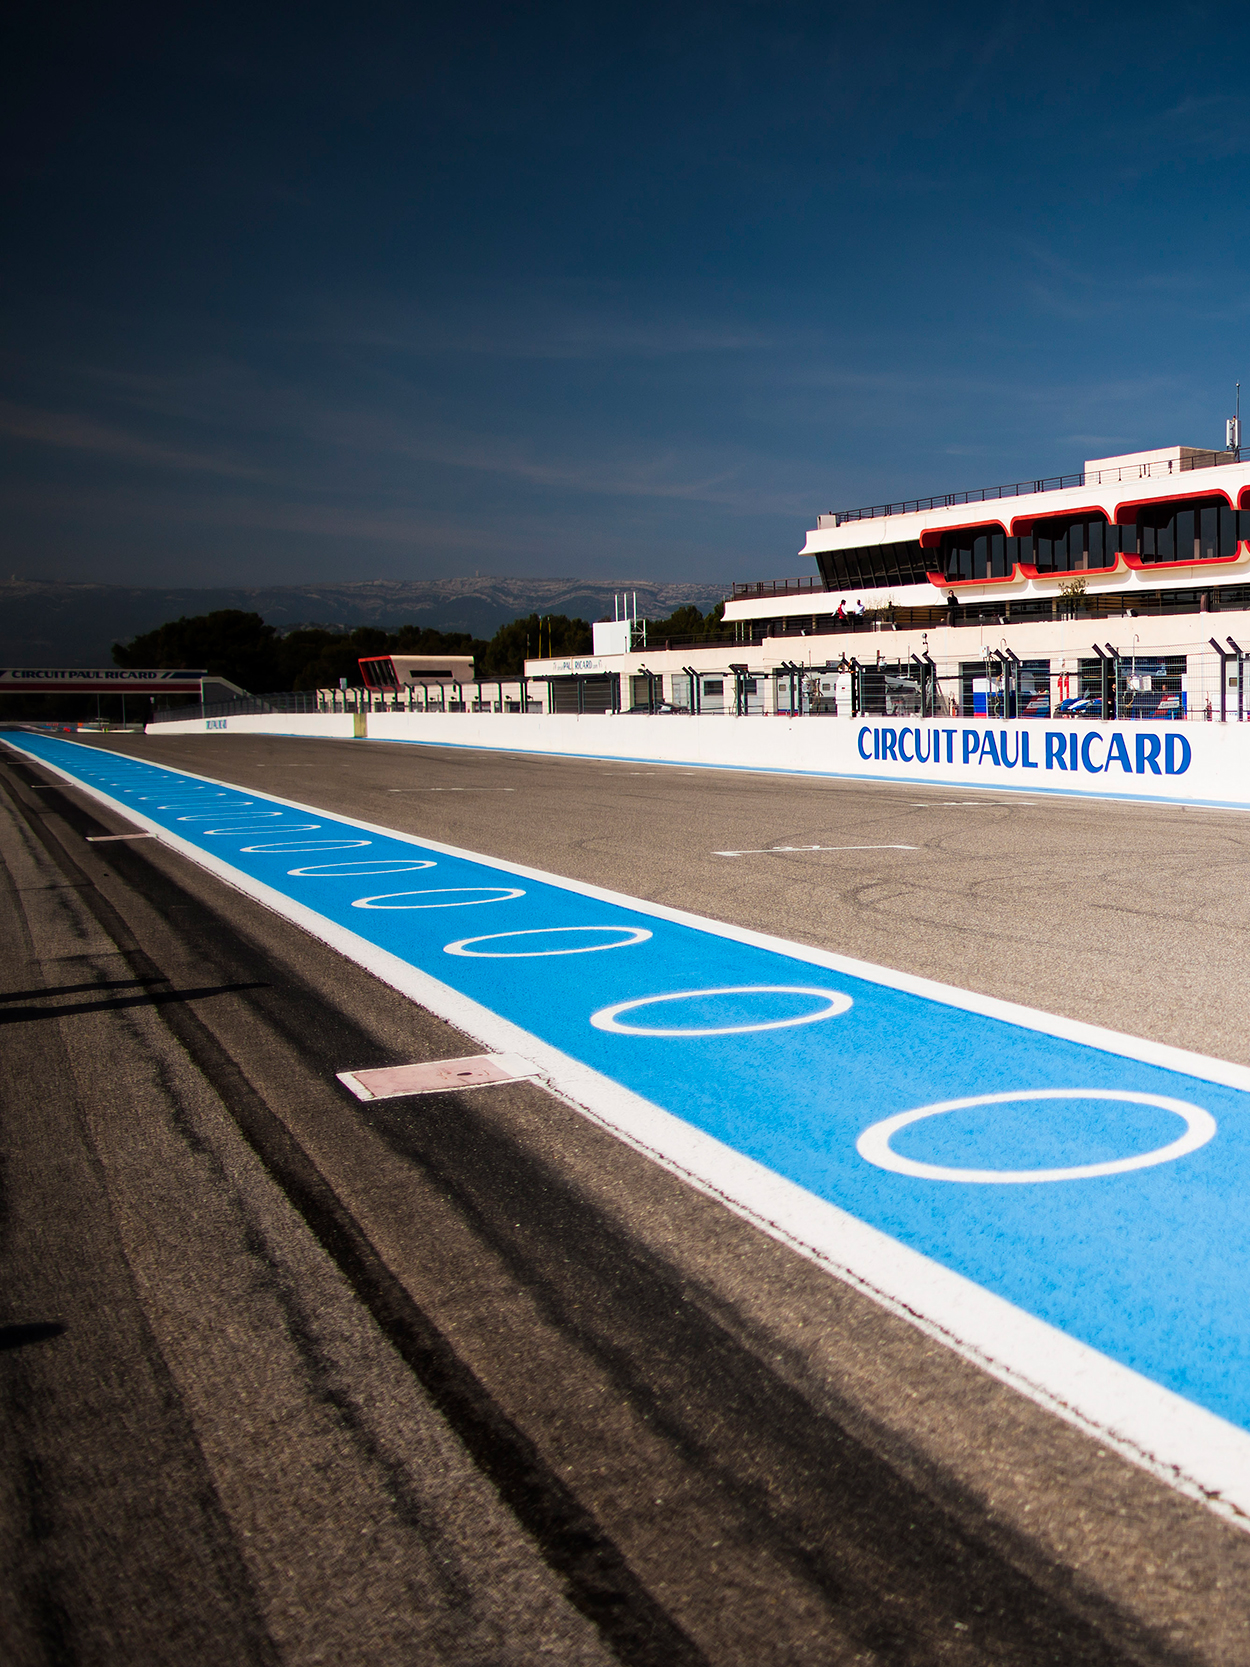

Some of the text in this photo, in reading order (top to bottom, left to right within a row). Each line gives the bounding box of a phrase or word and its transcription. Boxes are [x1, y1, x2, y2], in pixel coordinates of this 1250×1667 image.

[11, 670, 157, 680] CIRCUIT PAUL RICARD
[858, 726, 1192, 775] CIRCUIT PAUL RICARD
